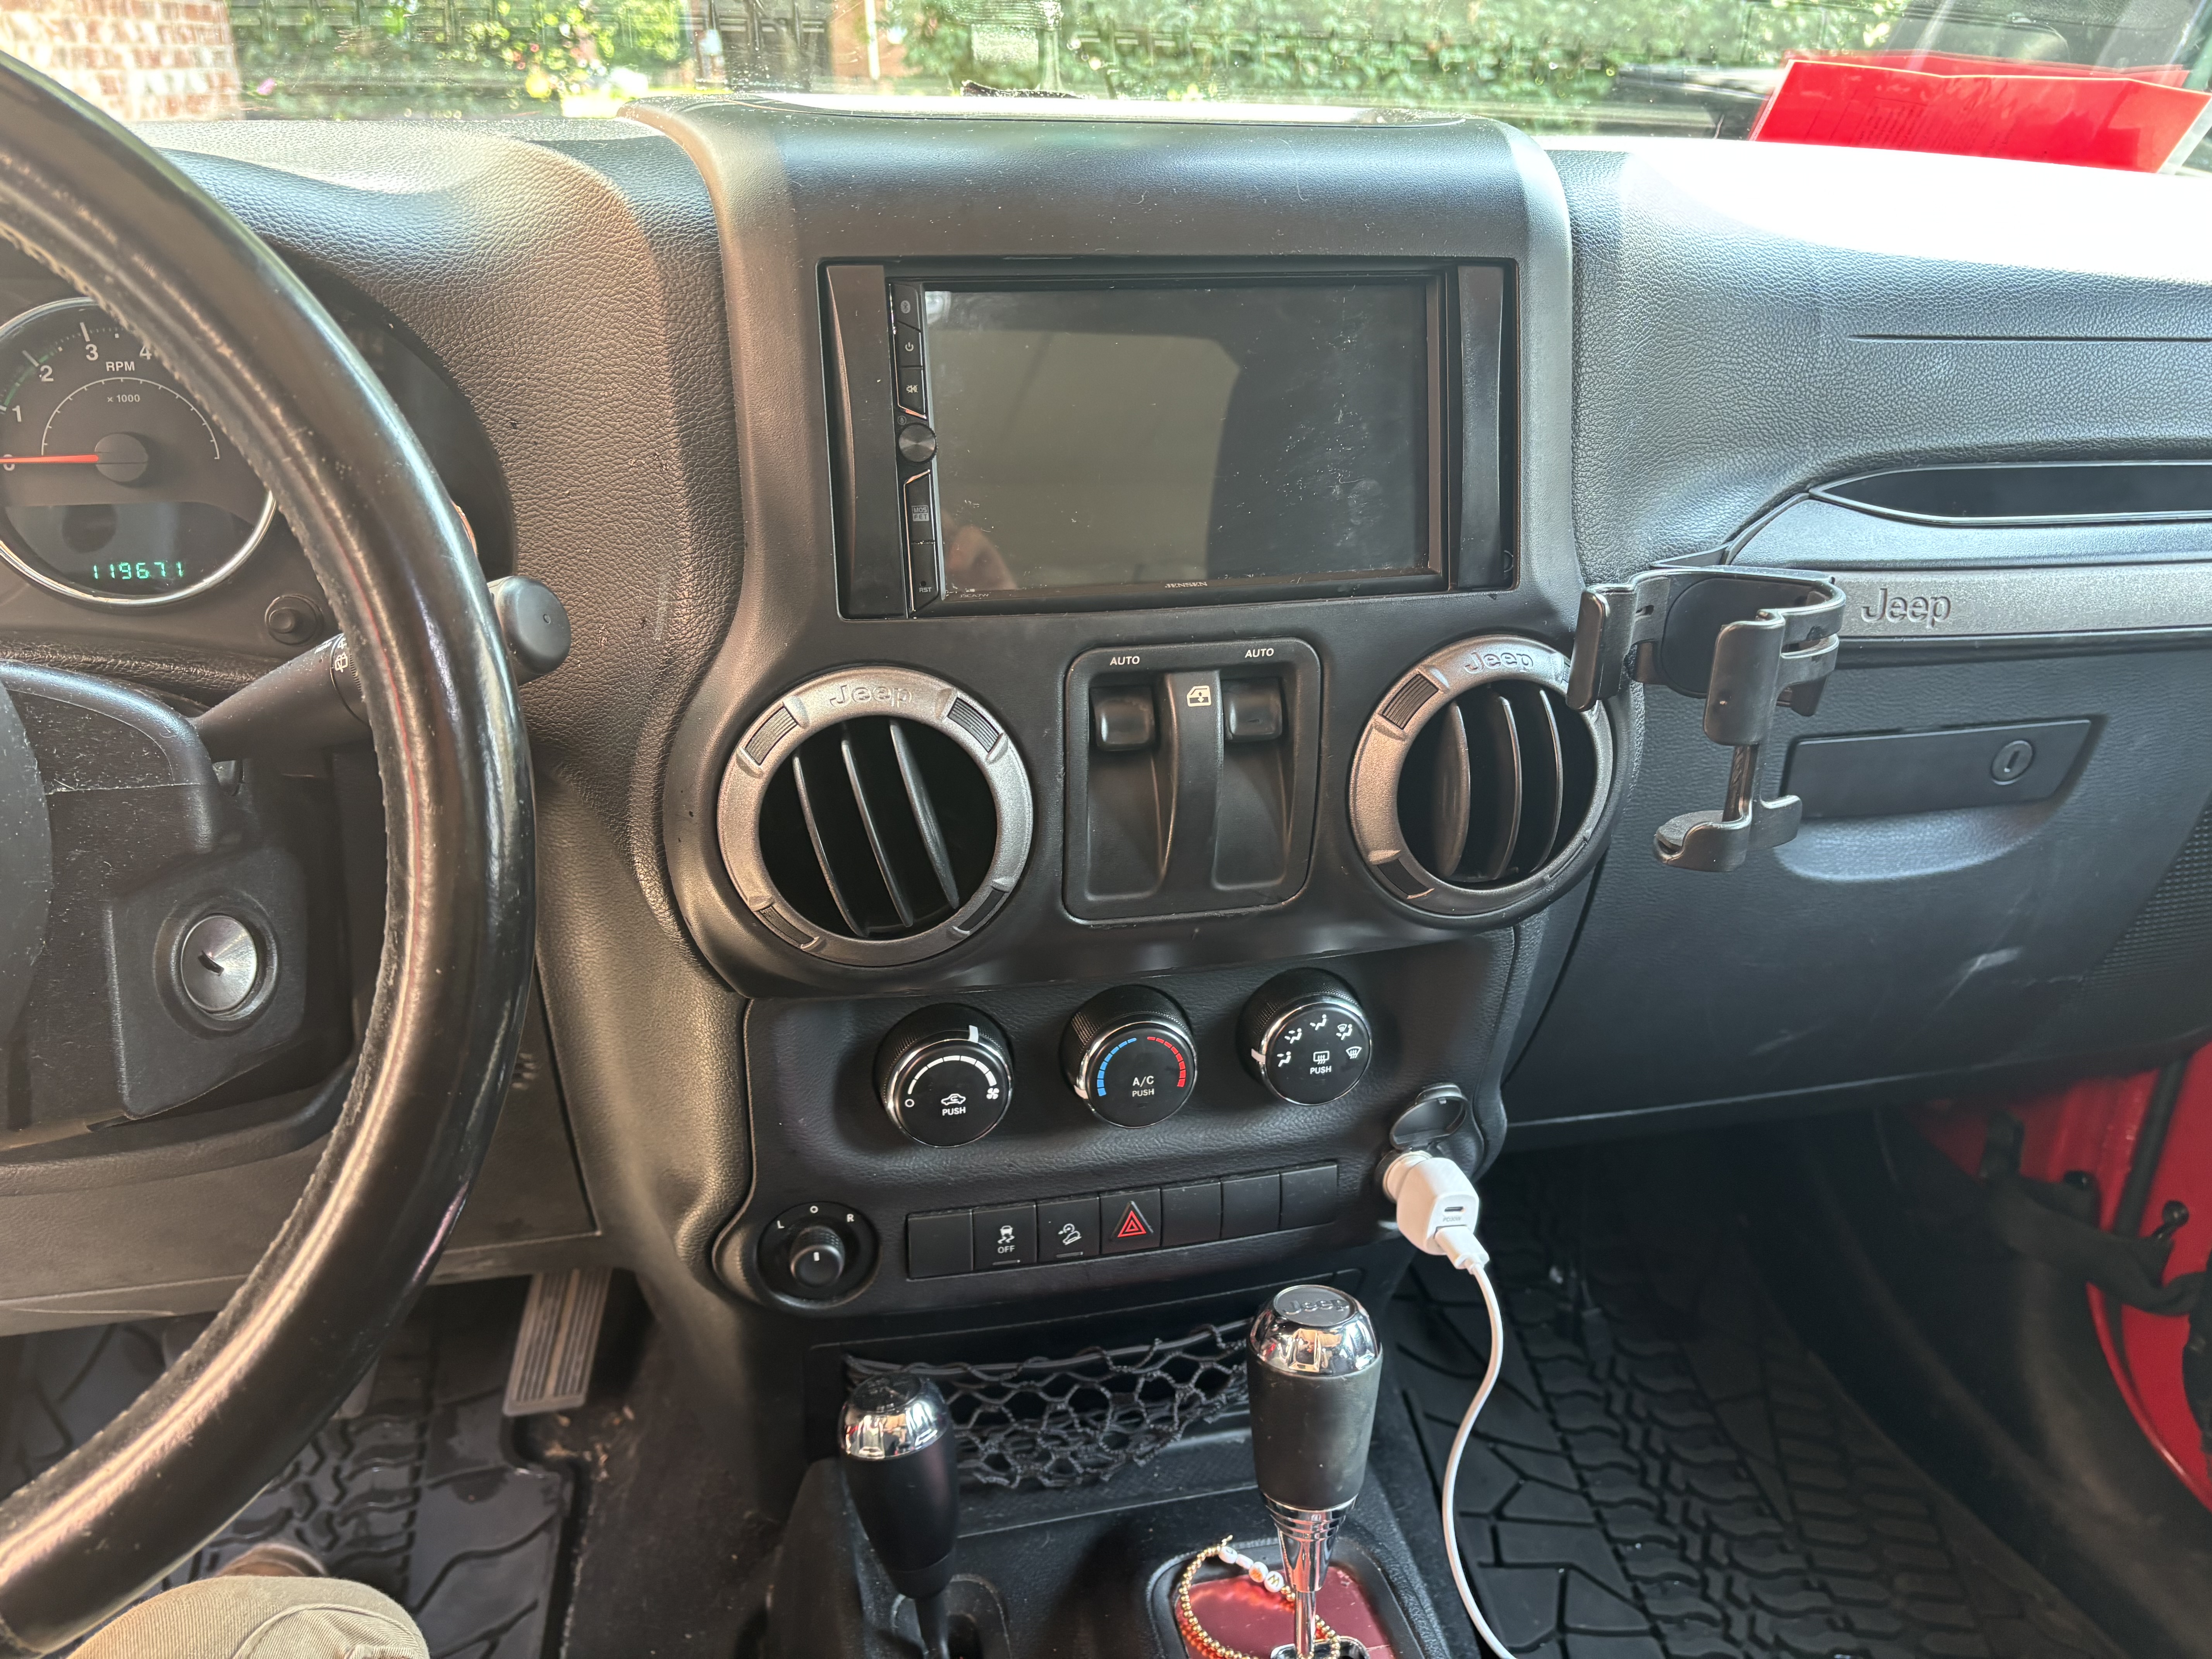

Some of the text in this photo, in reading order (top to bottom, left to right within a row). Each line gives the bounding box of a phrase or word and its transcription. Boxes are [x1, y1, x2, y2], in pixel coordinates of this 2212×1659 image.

[86, 344, 99, 361] 3
[139, 345, 152, 360] 4
[106, 361, 135, 371] RPM
[40, 365, 54, 382] 2
[117, 394, 140, 402] 1000
[12, 405, 22, 422] 1
[94, 562, 183, 579] 119671
[1861, 588, 1951, 630] Jeep
[1245, 648, 1274, 658] AUTO
[1109, 656, 1140, 666] AUTO
[1464, 652, 1534, 674] Jeep
[830, 684, 912, 708] Jeep
[1310, 1065, 1332, 1074] PUSH
[1132, 1075, 1154, 1087] A/C
[1132, 1088, 1154, 1097] PUSH
[942, 1106, 966, 1116] PUSH
[847, 1214, 855, 1222] R
[777, 1220, 785, 1229] L
[997, 1245, 1015, 1254] OFF
[1283, 1299, 1350, 1315] Jeep
